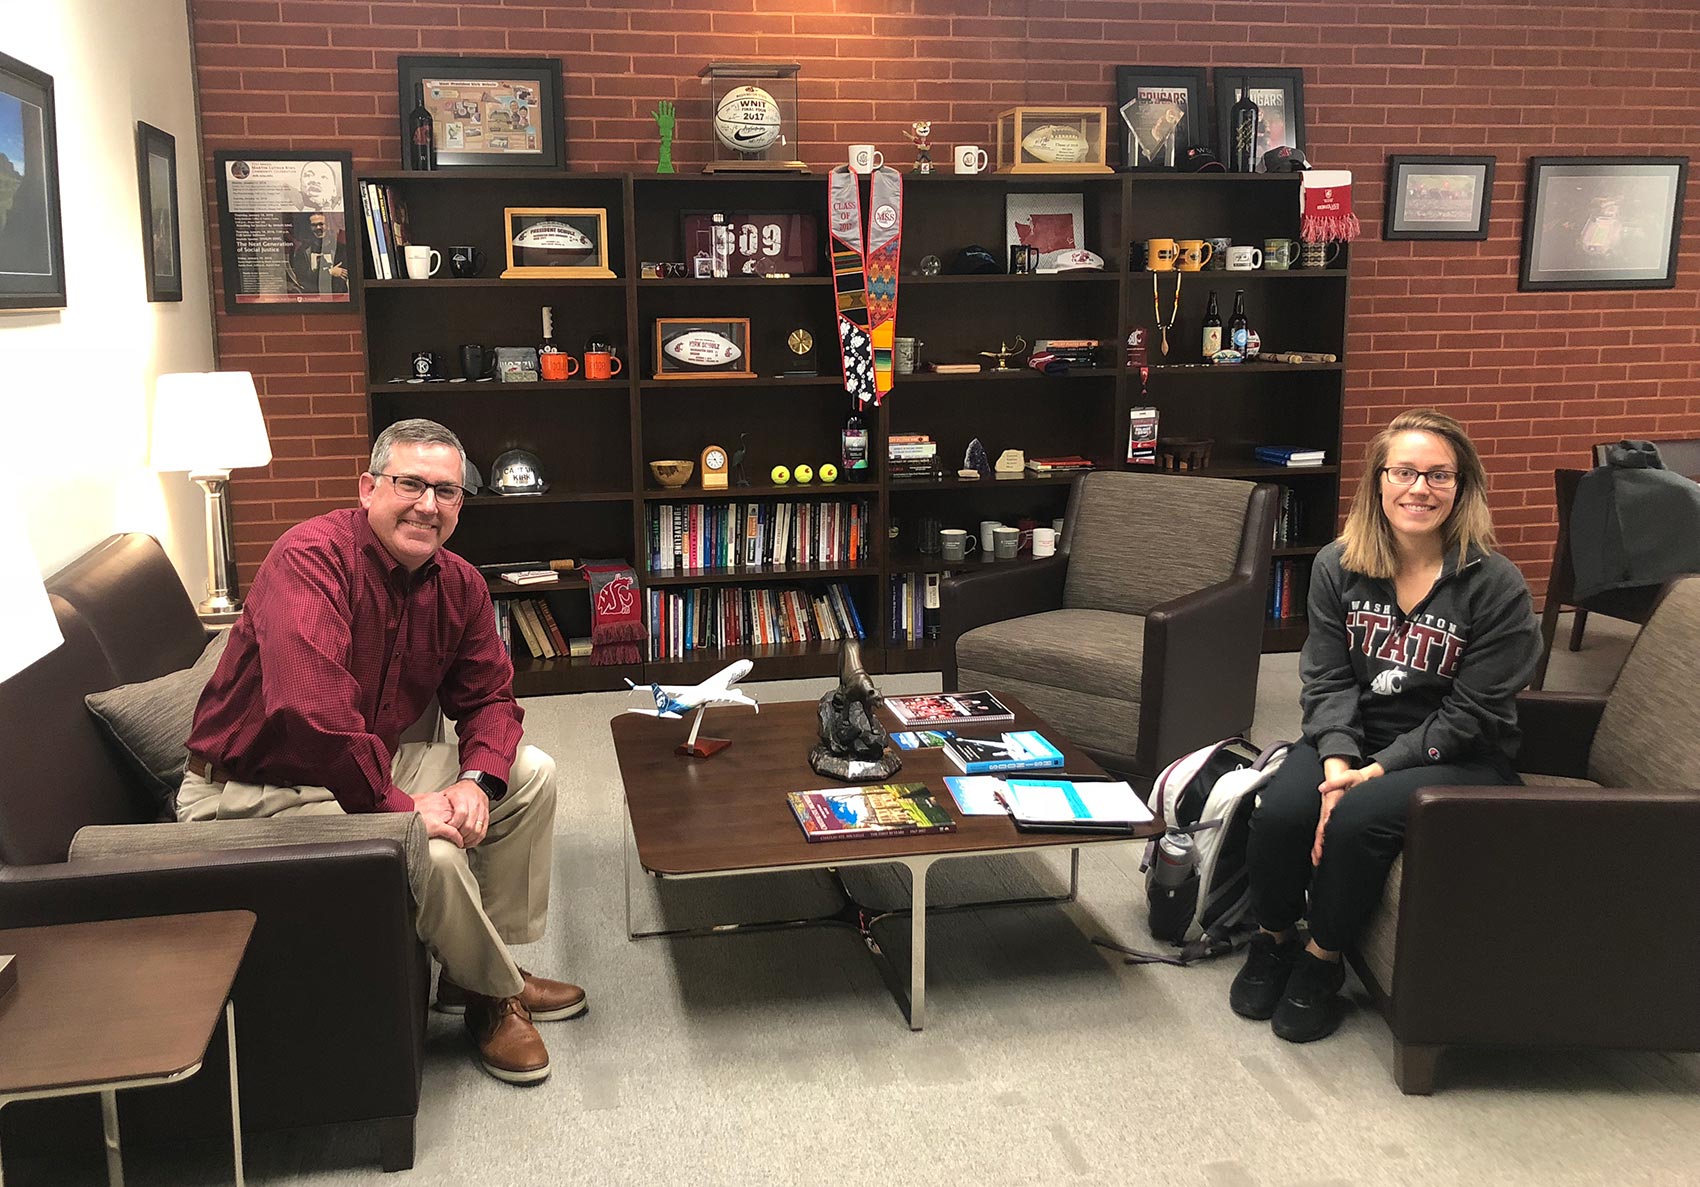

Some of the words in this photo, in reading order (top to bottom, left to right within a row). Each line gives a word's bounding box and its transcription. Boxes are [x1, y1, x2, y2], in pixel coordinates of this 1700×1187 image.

[1139, 91, 1187, 105] COUGARS
[1235, 93, 1283, 106] CUGARS
[740, 100, 766, 108] WNIT
[743, 112, 765, 121] 2017
[833, 202, 857, 211] CLASS
[840, 212, 851, 220] OF
[876, 212, 895, 222] MSS
[530, 227, 557, 235] PRESIDENT
[673, 511, 682, 555] UNRAVELING
